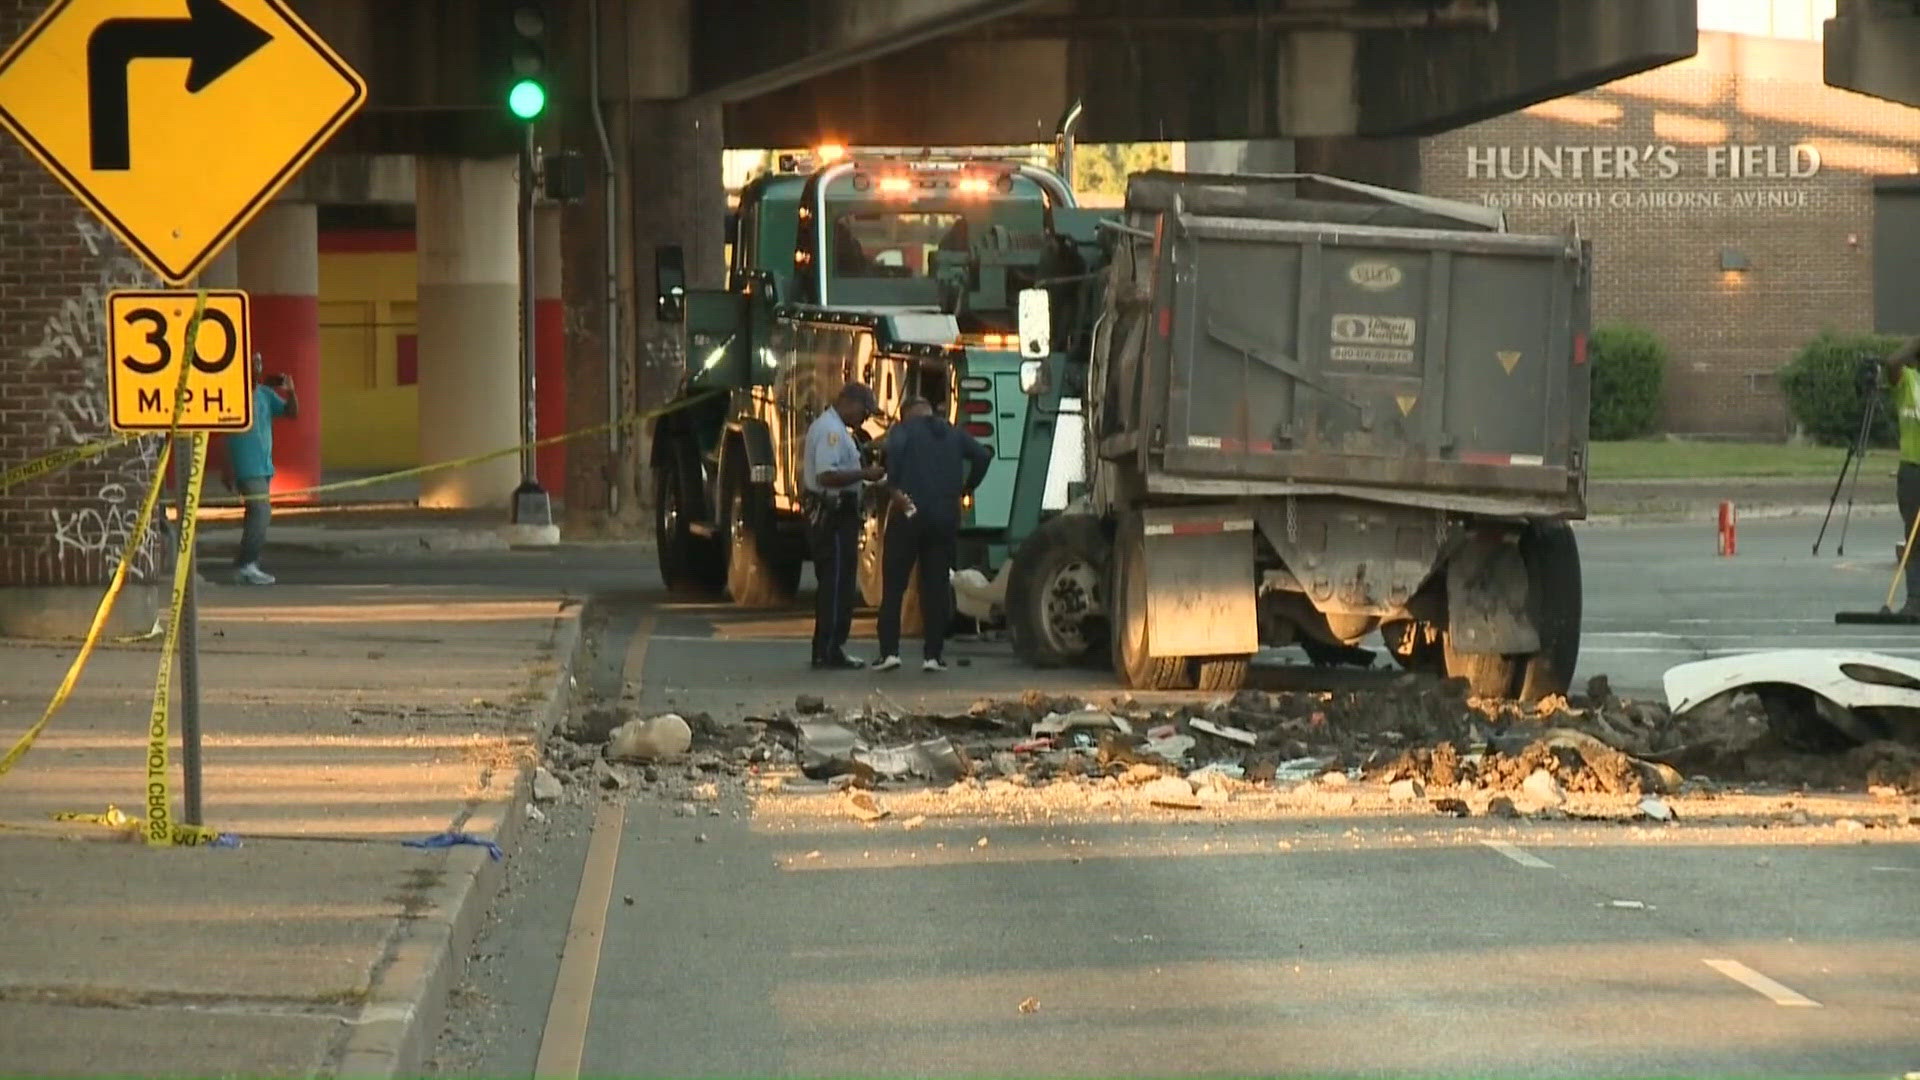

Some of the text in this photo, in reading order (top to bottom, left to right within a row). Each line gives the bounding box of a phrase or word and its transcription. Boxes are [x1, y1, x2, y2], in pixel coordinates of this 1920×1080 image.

[1466, 144, 1822, 180] HUNTER'S FIELD
[1532, 191, 1601, 209] NORTH
[1610, 190, 1724, 208] CLAIBORNE
[1732, 190, 1809, 208] AVENUE
[122, 307, 237, 374] 30
